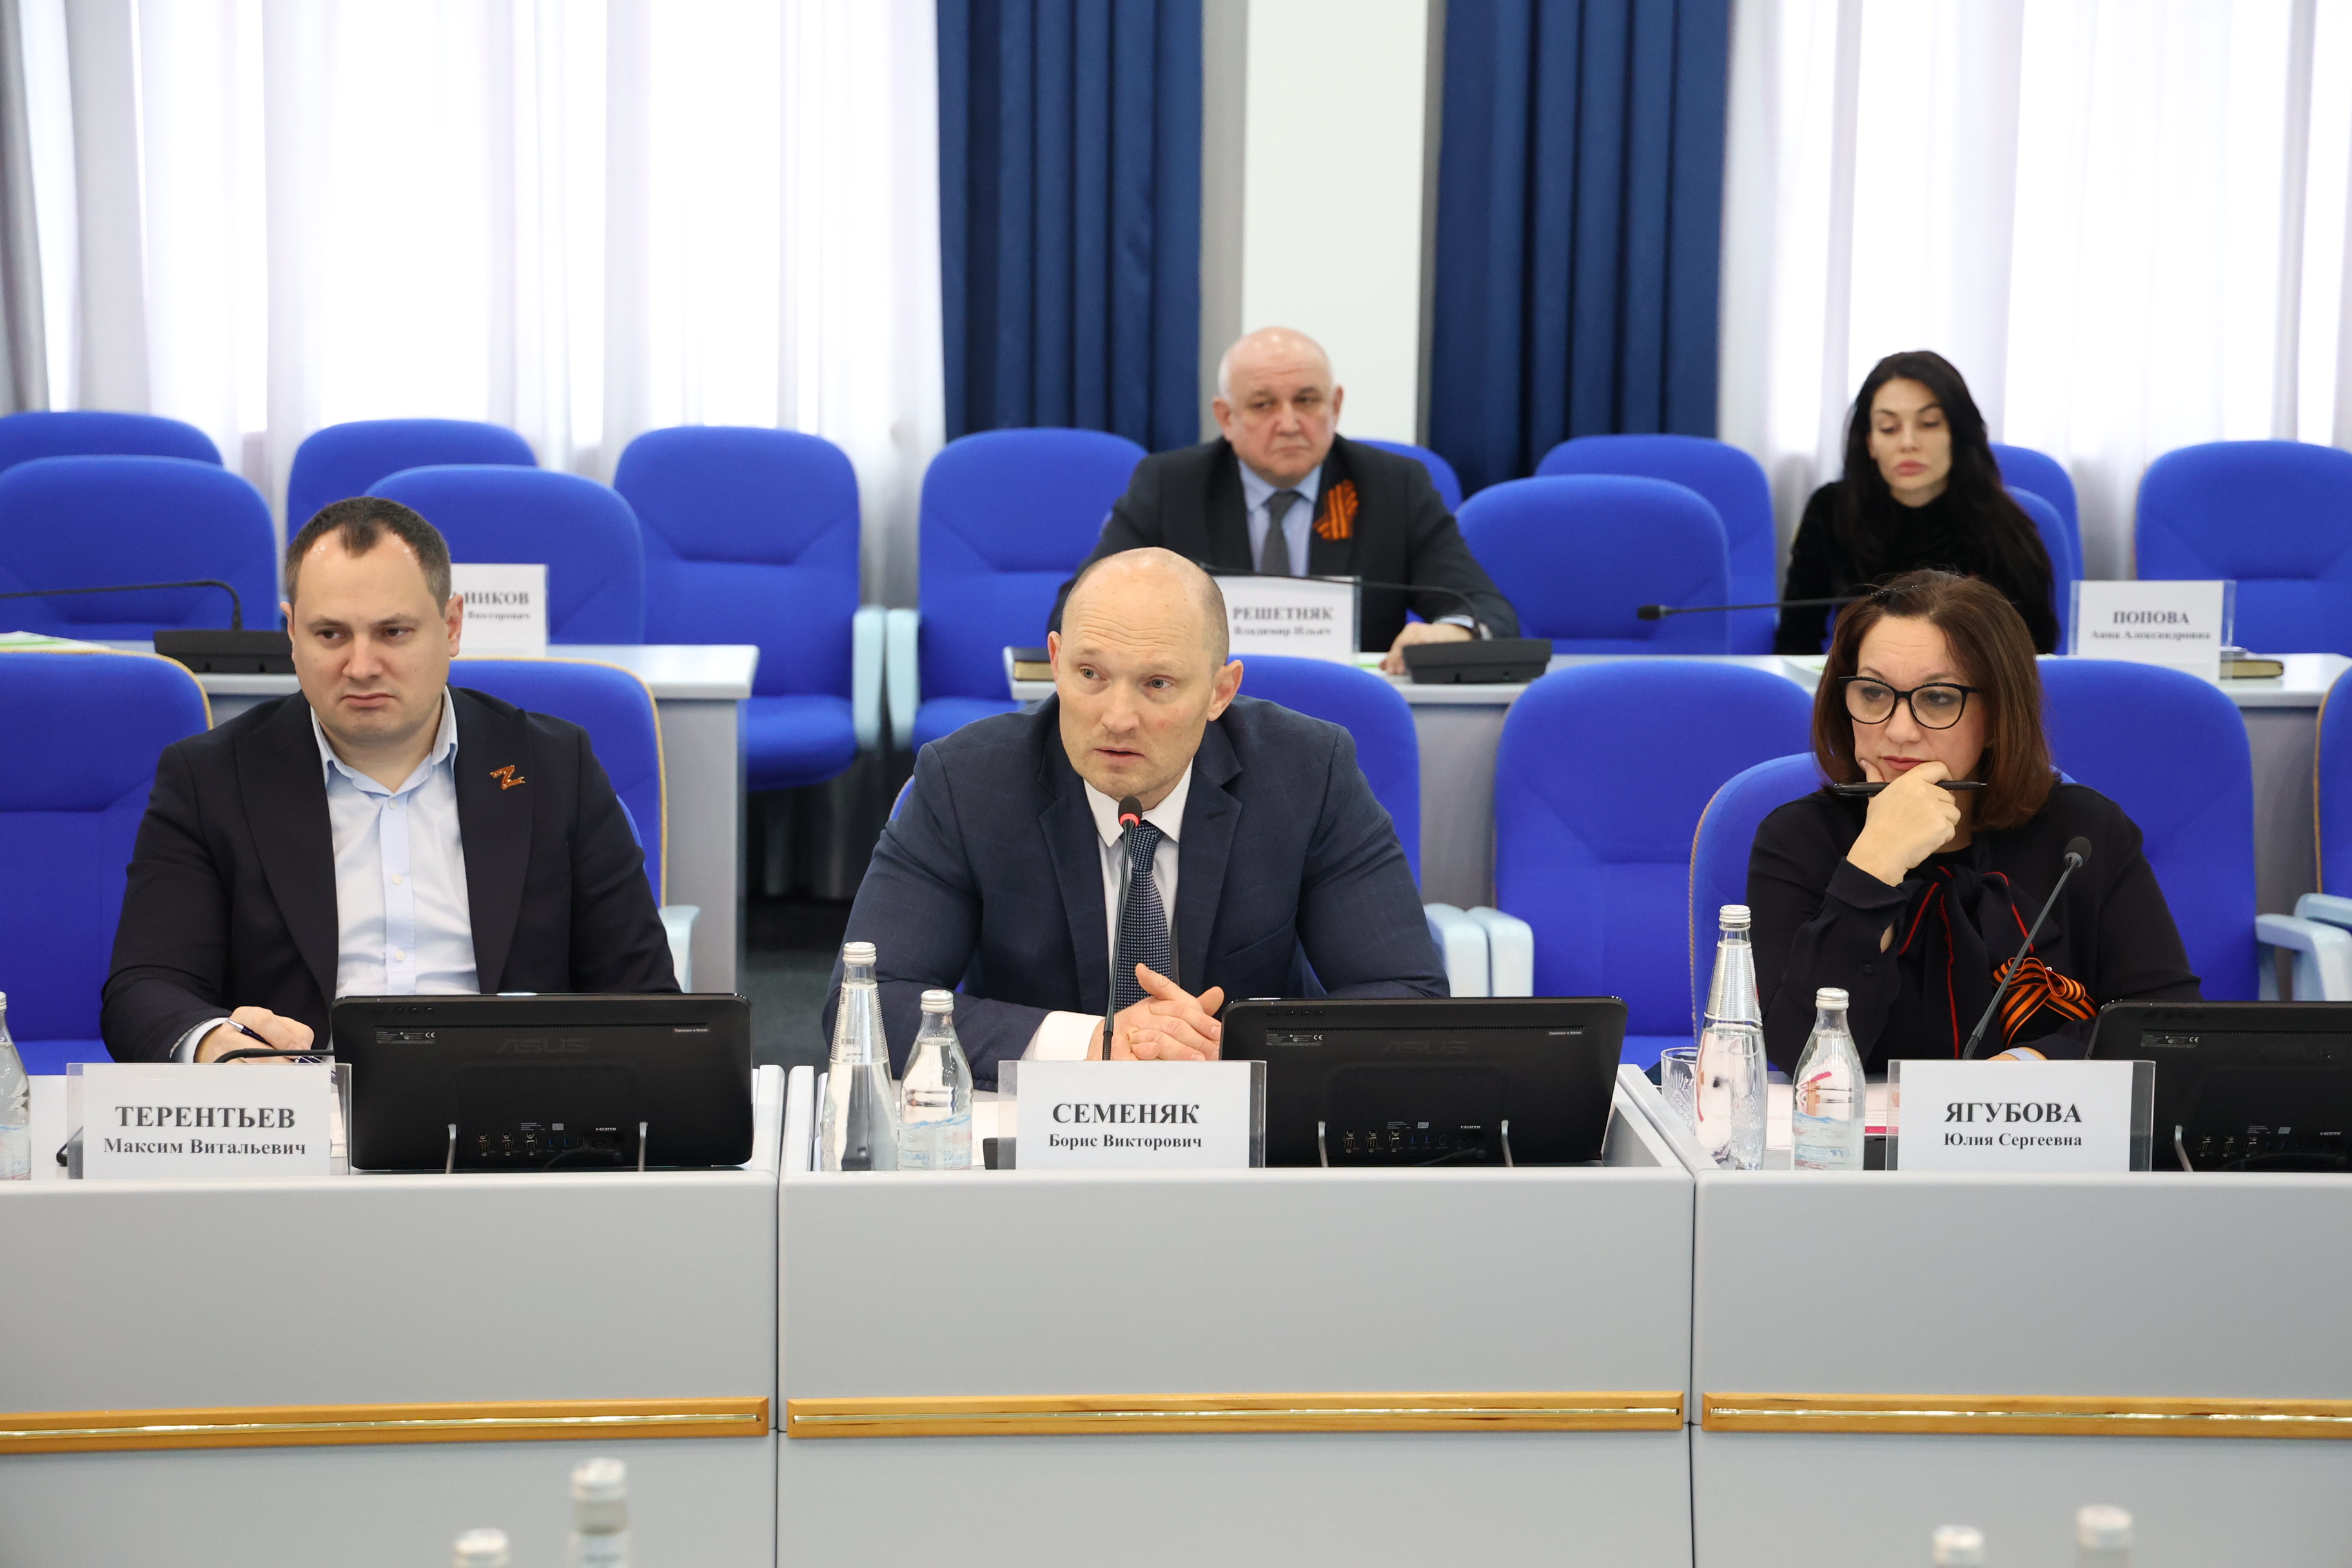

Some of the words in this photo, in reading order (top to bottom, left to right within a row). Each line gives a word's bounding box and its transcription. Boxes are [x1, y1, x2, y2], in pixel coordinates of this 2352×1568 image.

[452, 591, 530, 605] НИКОВ
[1233, 607, 1333, 620] РЕШЕТНЯК
[2113, 610, 2190, 625] ПОПОВА
[115, 1106, 295, 1128] ТЕРЕНТЬЕВ
[1052, 1103, 1199, 1124] СЕМЕНЯК
[1945, 1102, 2082, 1123] ЯГУБОВА
[104, 1137, 183, 1153] Максим
[190, 1139, 306, 1155] Витальевич
[1049, 1133, 1097, 1151] Борис
[1103, 1133, 1202, 1151] Викторович
[1944, 1132, 1994, 1146] Юлия
[1999, 1133, 2082, 1150] Сергеевна
